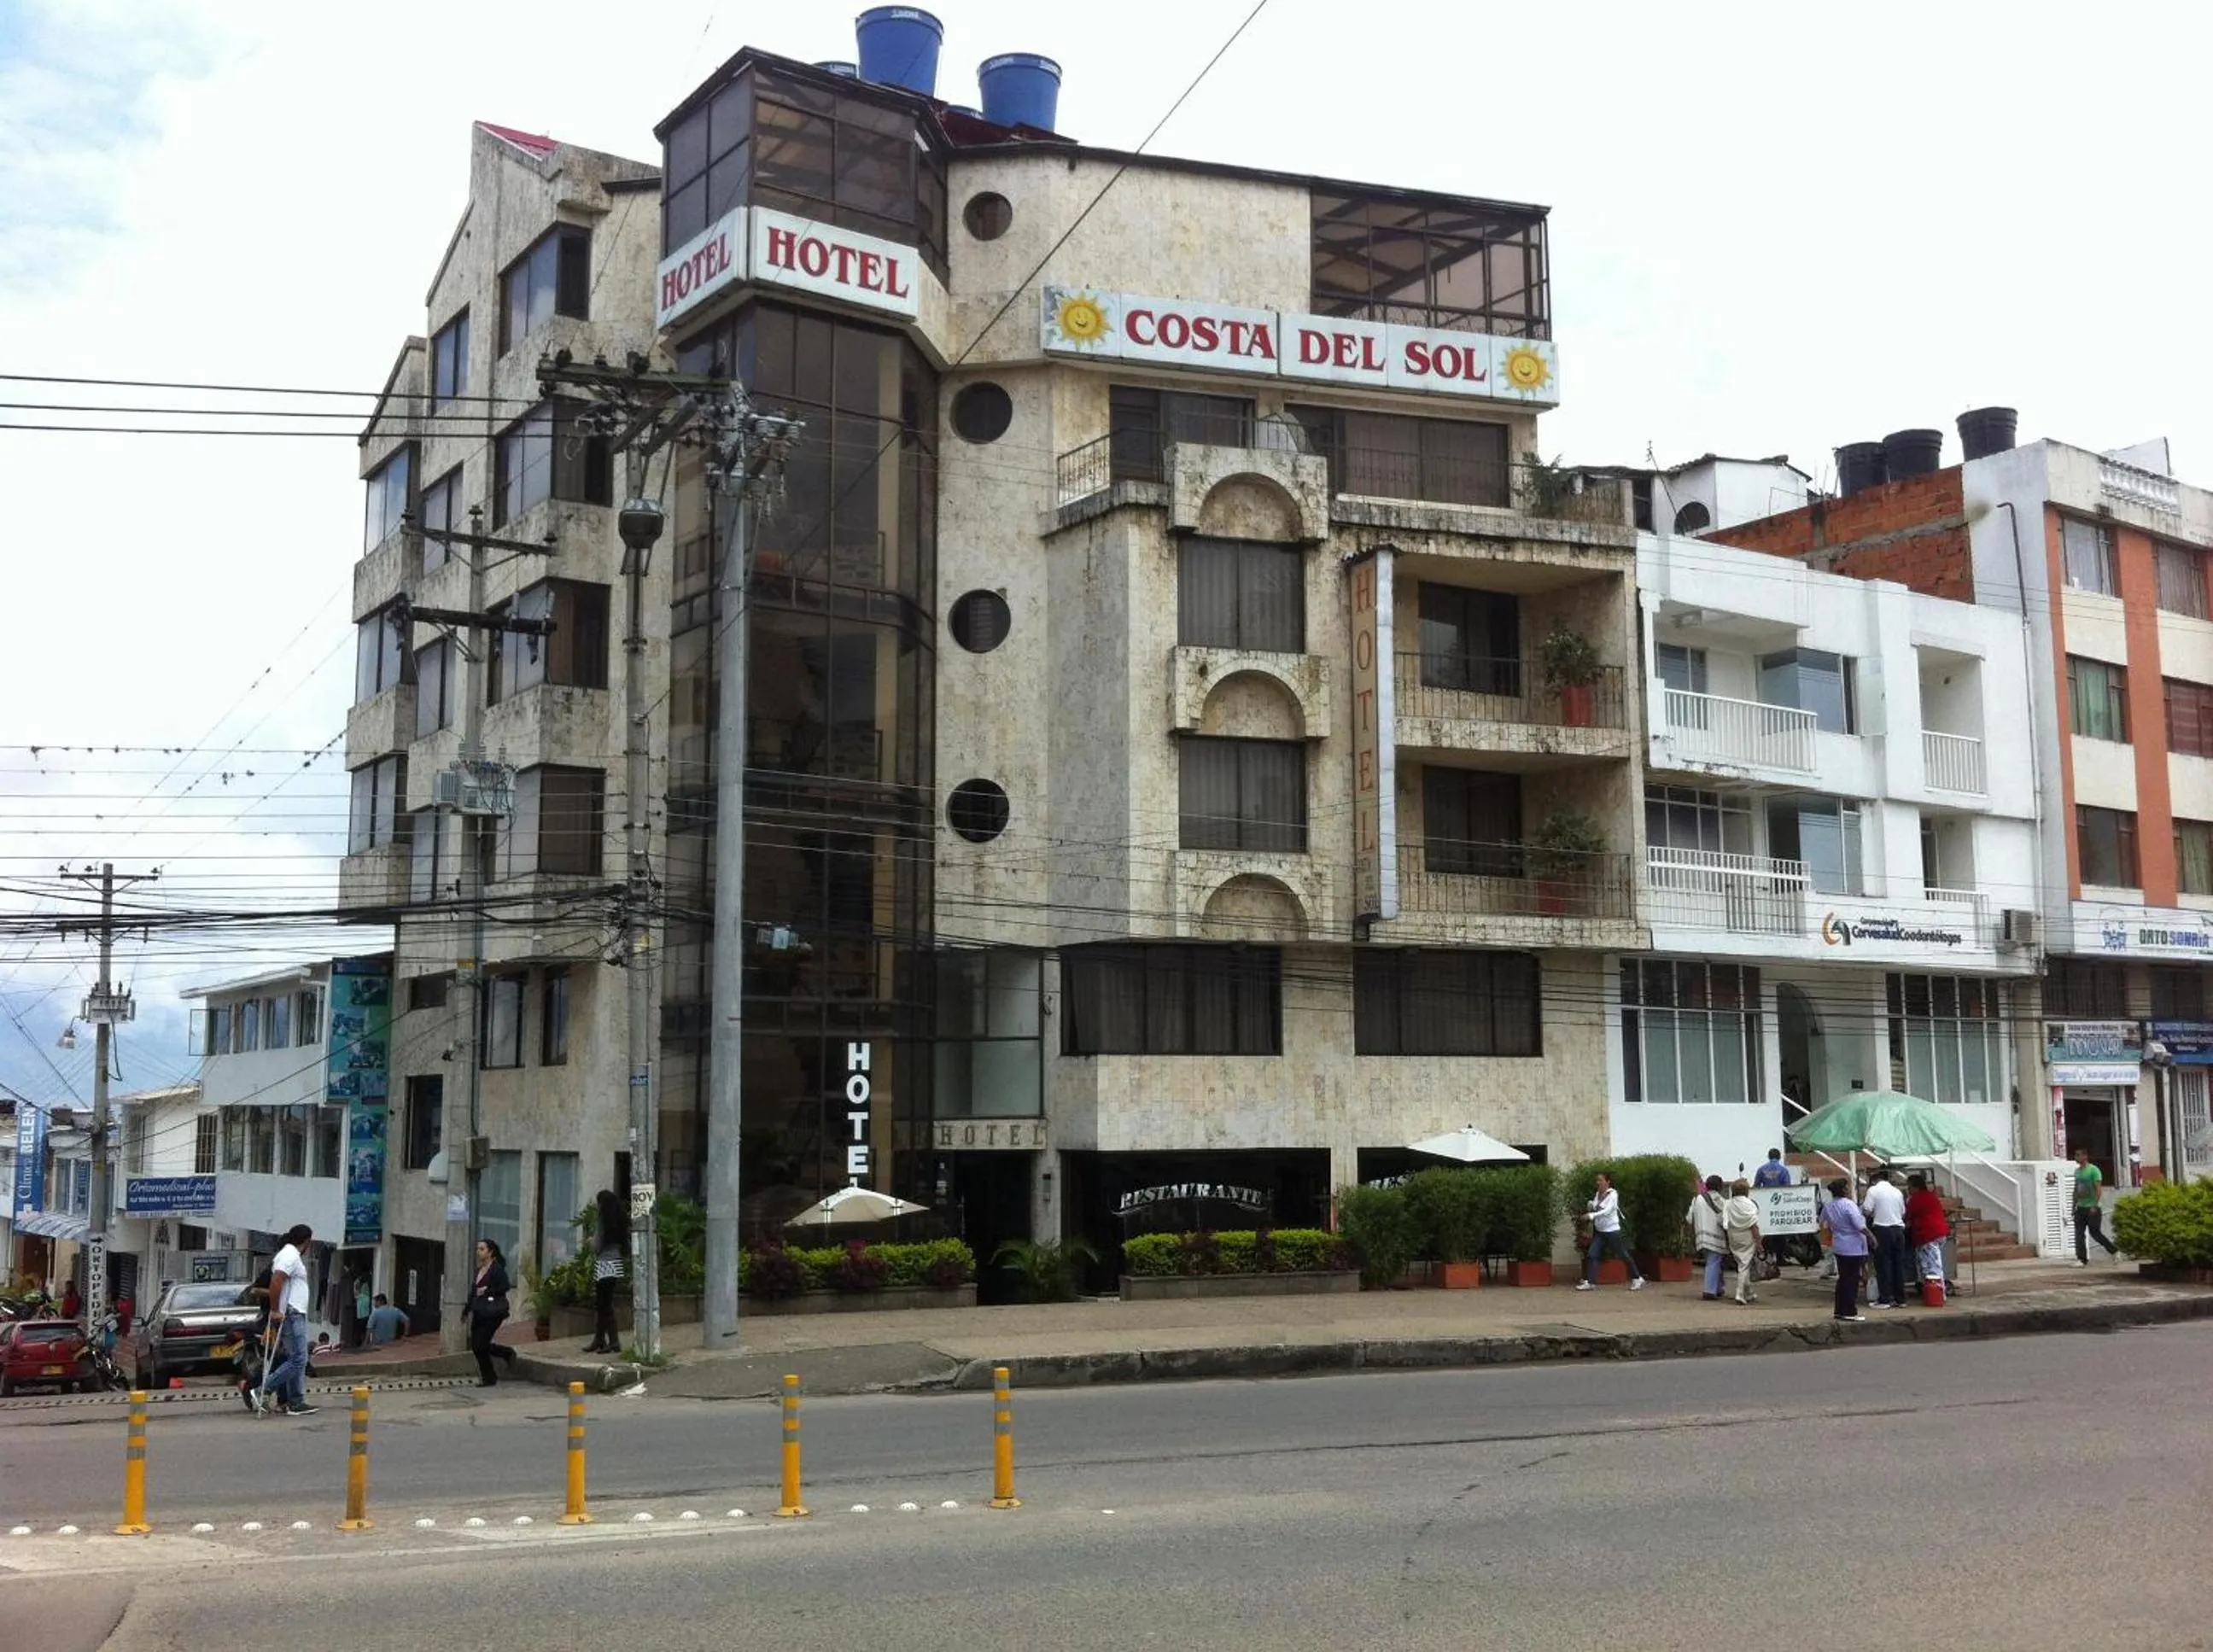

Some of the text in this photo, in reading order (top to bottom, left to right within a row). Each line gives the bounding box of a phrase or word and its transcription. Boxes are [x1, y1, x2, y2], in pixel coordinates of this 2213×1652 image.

[661, 231, 732, 311] HOTEL
[767, 225, 909, 299] HOTEL
[1124, 308, 1486, 382] COSTA DEL SOL
[1357, 568, 1375, 851] HOTEL
[2139, 931, 2169, 945] ORTO
[20, 1107, 36, 1155] BELEN
[939, 1124, 1046, 1146] HOTEL
[1119, 1182, 1264, 1210] RESTAURANTE
[1770, 1217, 1813, 1226] PARQUEAR
